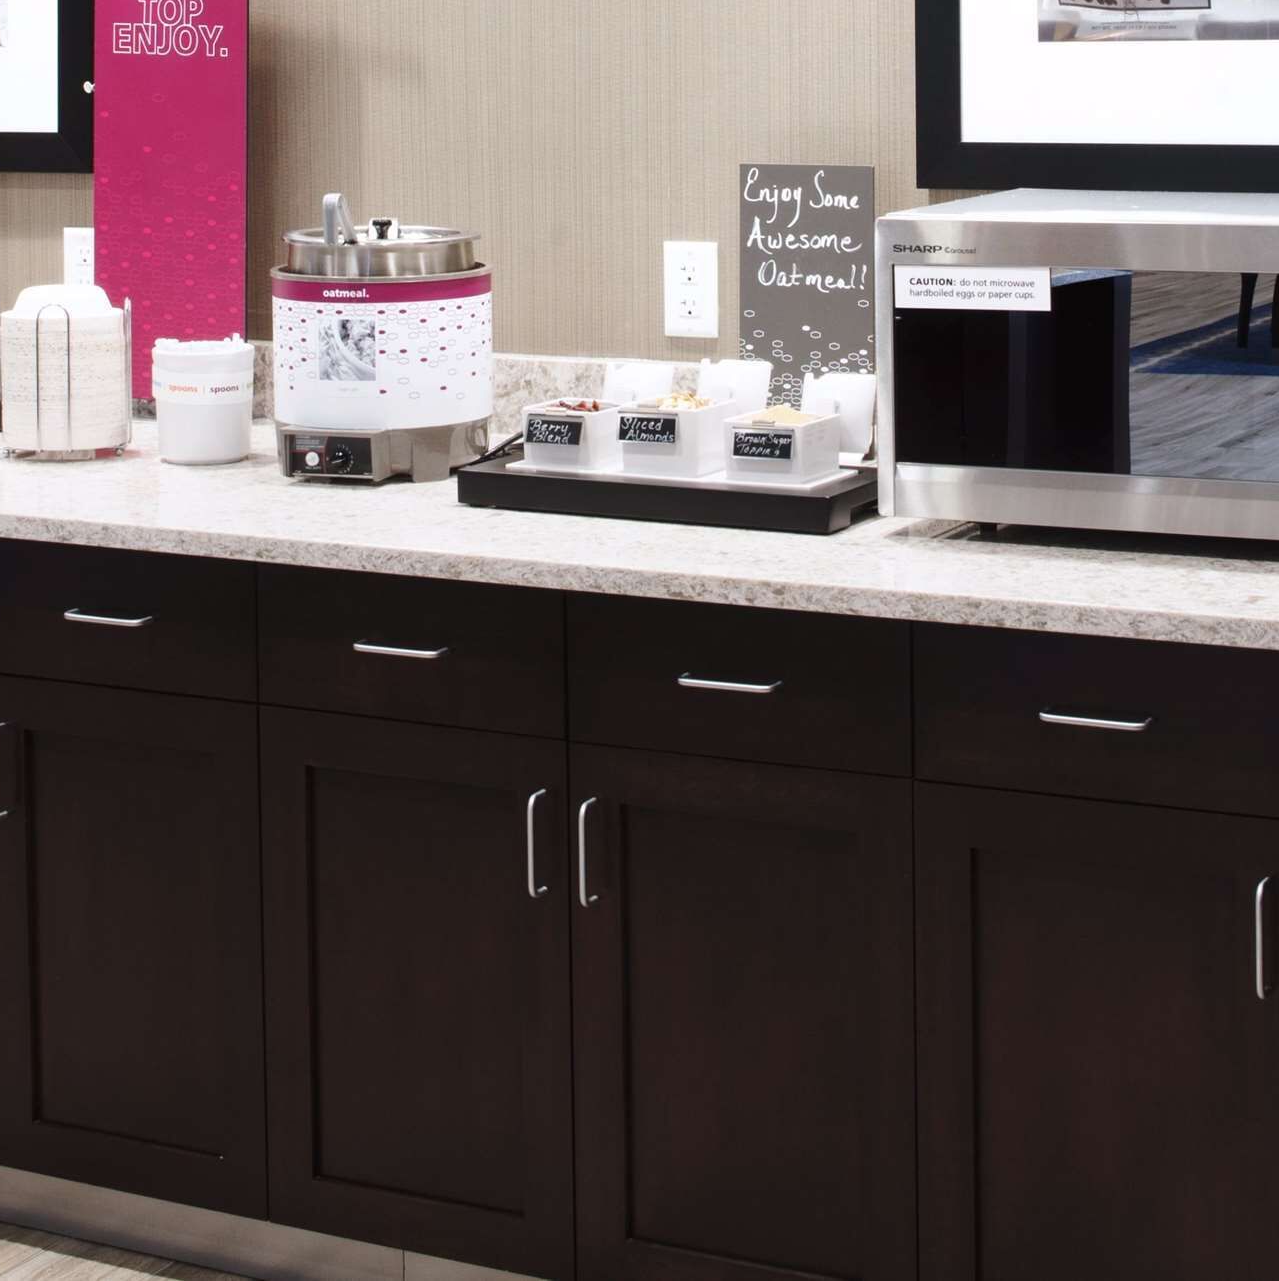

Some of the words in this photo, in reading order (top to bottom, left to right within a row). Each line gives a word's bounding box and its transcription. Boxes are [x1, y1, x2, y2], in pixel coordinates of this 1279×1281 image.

[112, 22, 229, 58] ENJOY.
[743, 167, 803, 228] Enjoy
[808, 169, 860, 210] Some
[746, 215, 863, 255] Awesome
[892, 244, 943, 254] SHARP
[909, 277, 957, 287] CAUTION:
[959, 278, 971, 287] do
[973, 279, 987, 288] not
[989, 278, 1036, 288] microwave
[322, 288, 370, 299] oatmeal.
[909, 289, 954, 298] hardboiled
[956, 291, 975, 301] eggs
[988, 292, 1013, 301] paper
[1014, 292, 1035, 301] cups.
[209, 385, 239, 395] spoons
[530, 418, 569, 432] Berry
[621, 417, 664, 431] Sliced
[532, 429, 571, 444] Blend
[625, 429, 675, 442] Almonds
